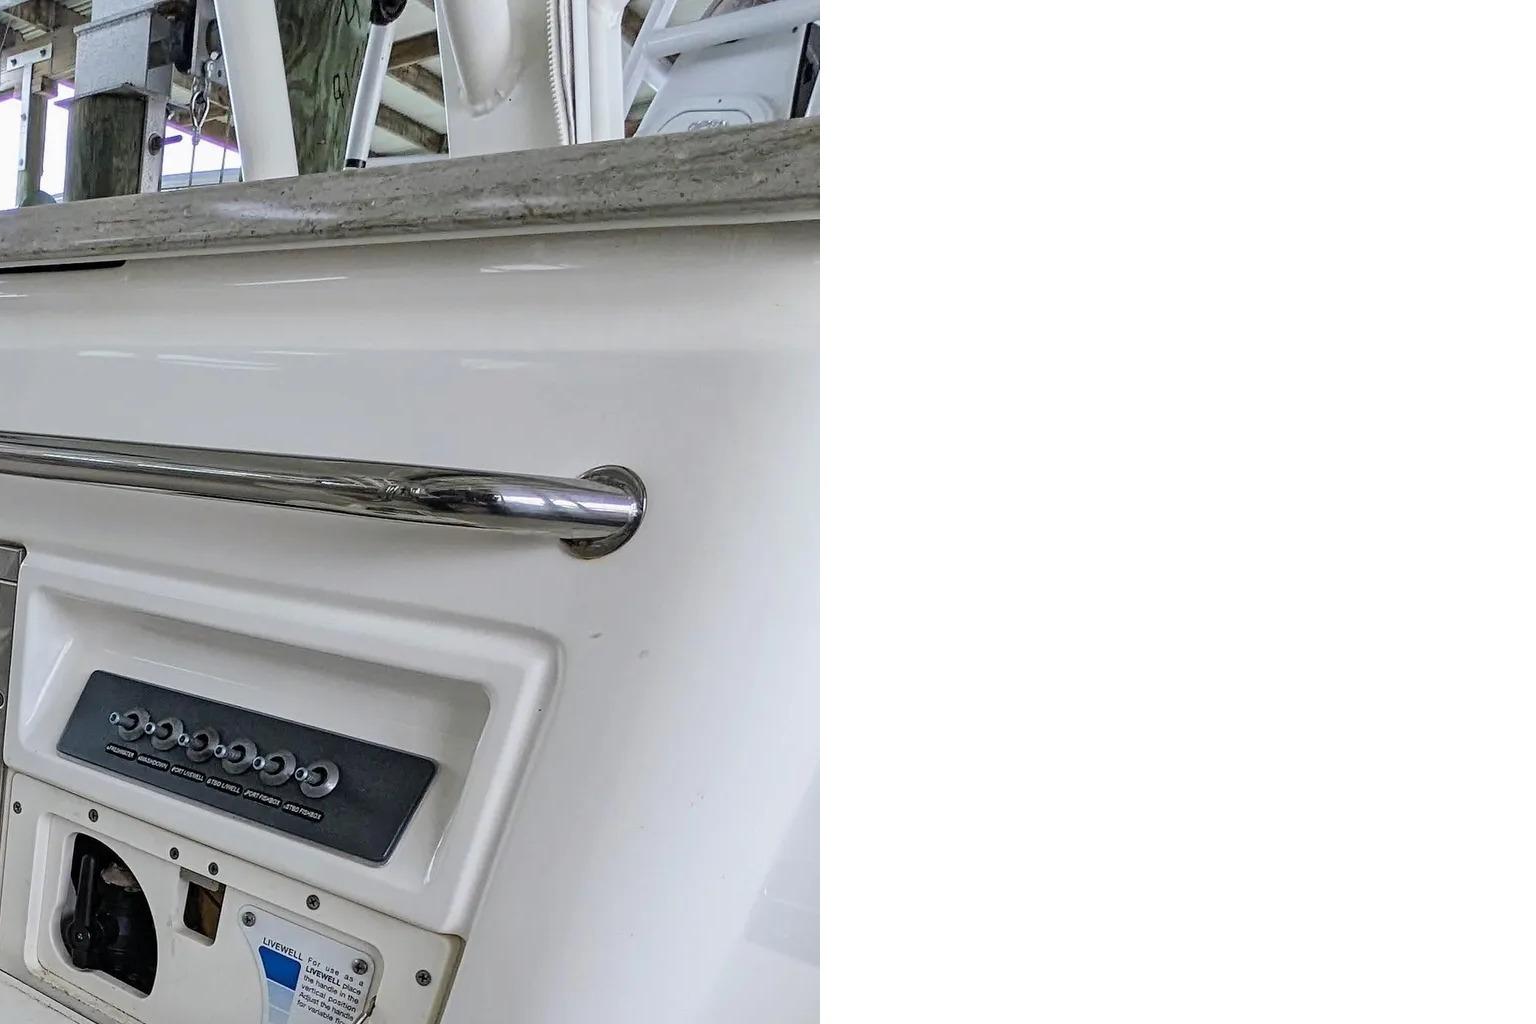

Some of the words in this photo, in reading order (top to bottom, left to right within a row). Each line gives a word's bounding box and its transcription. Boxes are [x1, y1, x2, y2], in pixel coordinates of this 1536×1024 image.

[263, 937, 303, 961] LIVEWELL
[306, 966, 341, 987] LIVEWELL
[342, 983, 361, 995] place
[308, 957, 321, 967] For
[325, 966, 339, 976] use
[344, 974, 354, 982] as
[301, 984, 326, 999] vertical
[328, 997, 357, 1013] position
[304, 974, 314, 984] the
[315, 980, 337, 995] handle
[347, 995, 359, 1004] the
[297, 1000, 306, 1008] for
[308, 1005, 333, 1021] variable
[298, 991, 319, 1005] Adjust
[320, 1001, 331, 1011] the
[332, 1006, 354, 1021] handle
